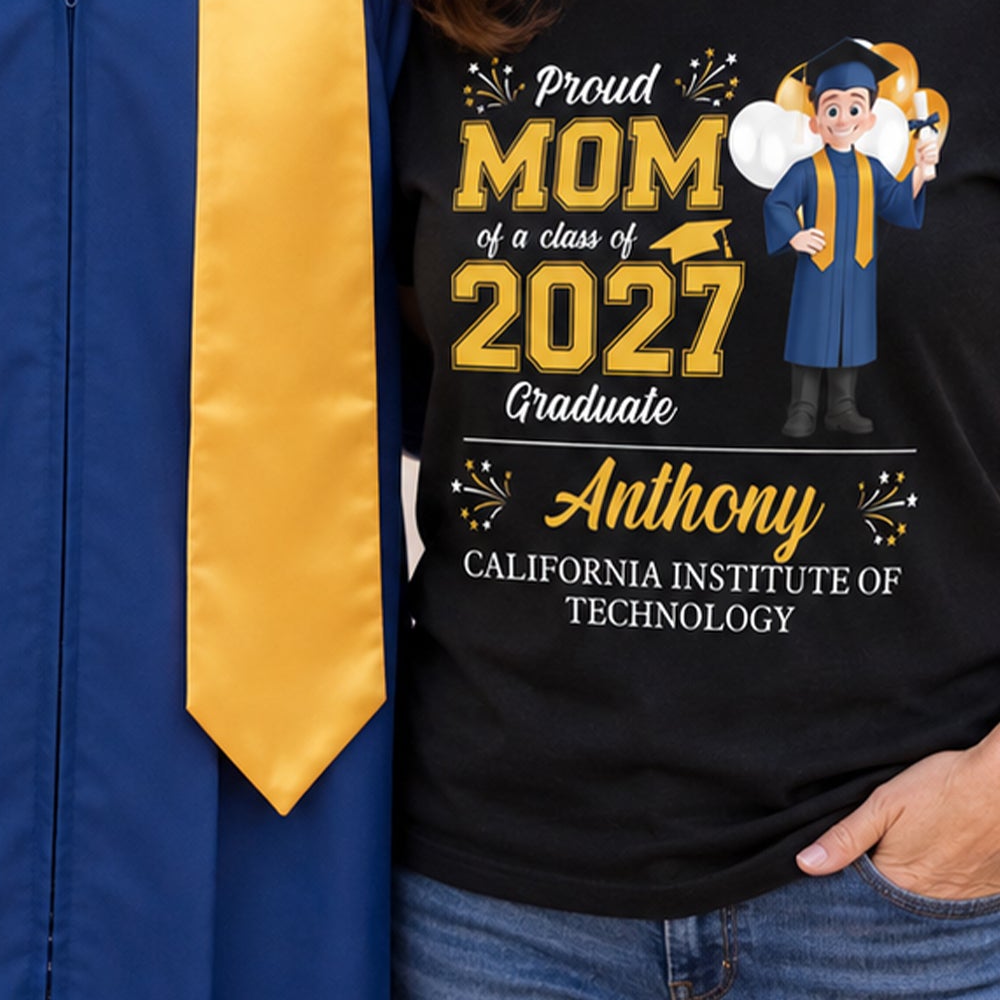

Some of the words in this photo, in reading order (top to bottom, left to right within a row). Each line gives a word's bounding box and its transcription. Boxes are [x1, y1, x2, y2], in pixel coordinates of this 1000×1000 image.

[535, 63, 661, 107] Proud
[453, 114, 728, 211] MOM
[477, 222, 503, 259] of
[512, 229, 528, 248] a
[540, 222, 602, 249] class
[610, 222, 637, 260] of
[451, 260, 745, 377] 2027
[506, 381, 677, 425] Graduate
[545, 457, 825, 563] Anthony
[464, 550, 662, 588] CALIFORNIA
[672, 562, 850, 594] INSTITUTE
[858, 567, 901, 595] OF
[565, 597, 795, 632] TECHNOLOGY
